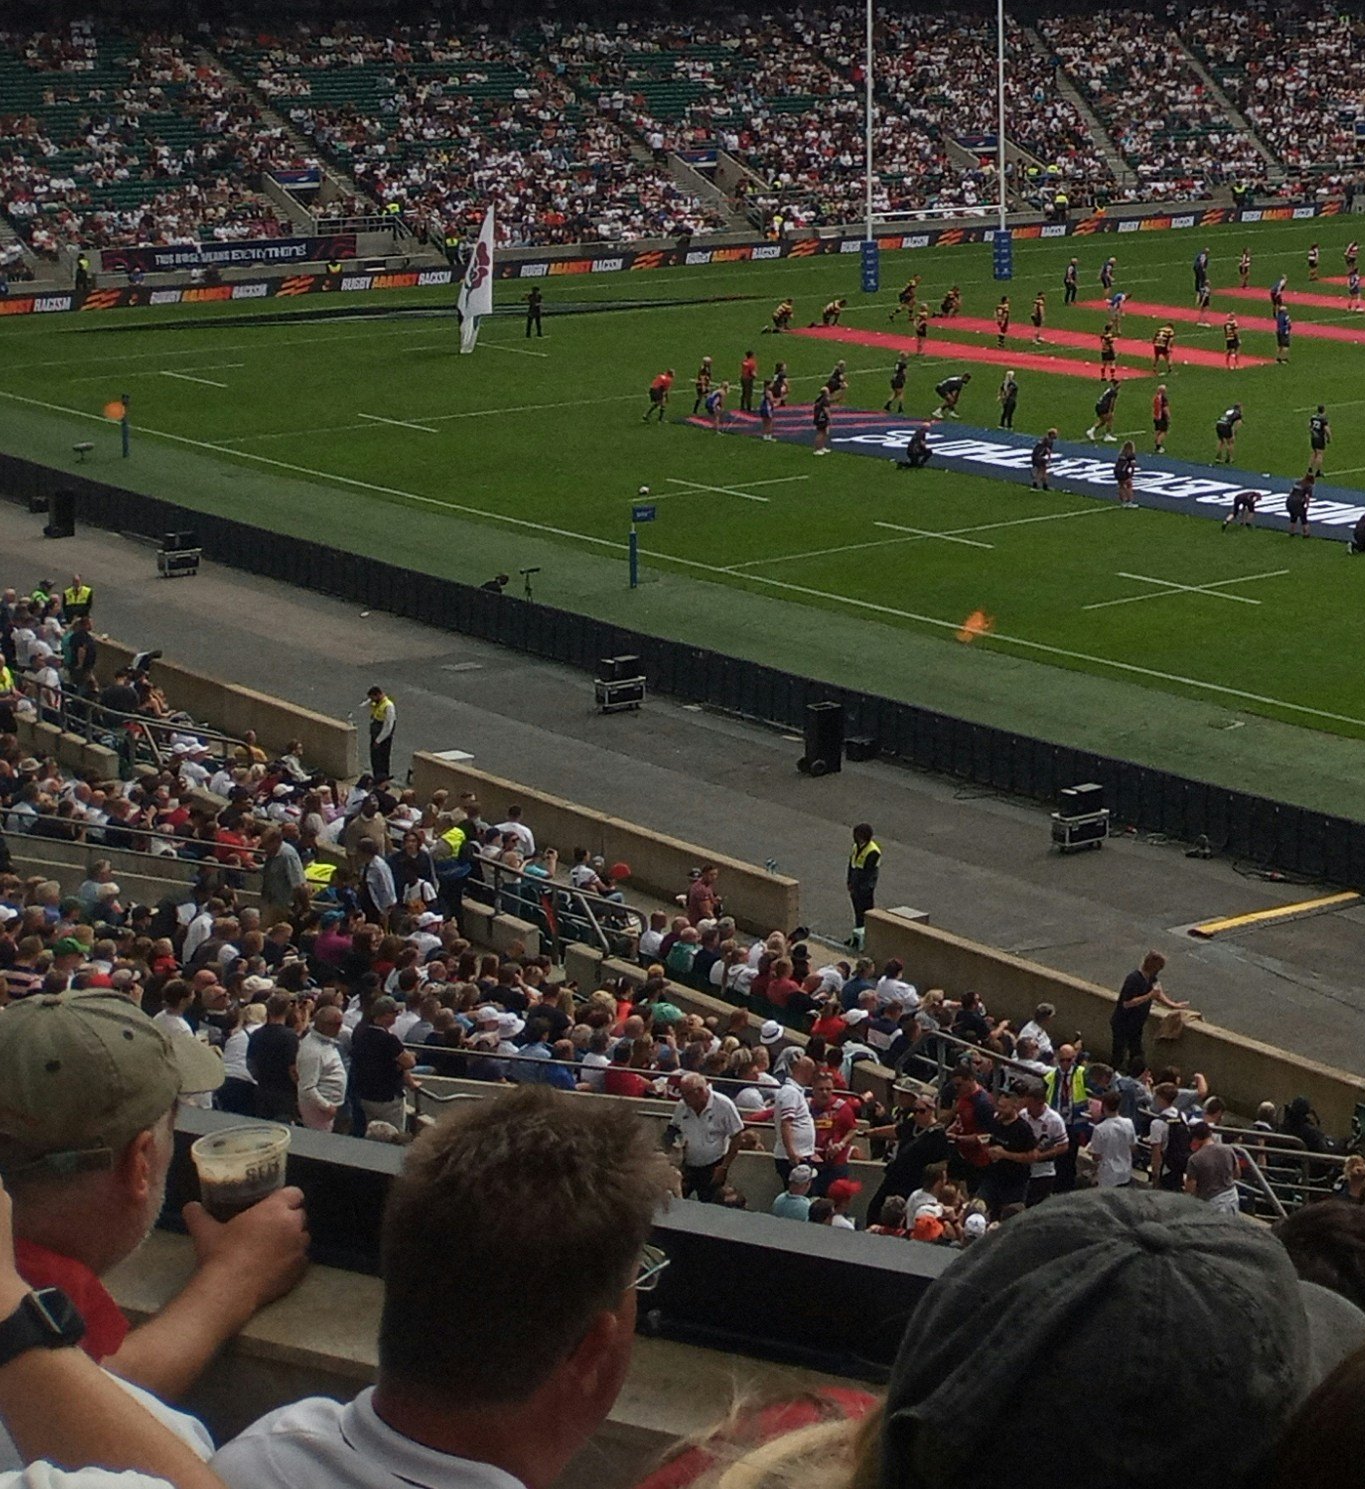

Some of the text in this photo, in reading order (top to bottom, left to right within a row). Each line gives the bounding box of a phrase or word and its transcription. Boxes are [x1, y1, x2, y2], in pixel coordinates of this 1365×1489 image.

[341, 271, 451, 291] RUGBY AGAINST RACISM
[33, 297, 71, 312] RACISM
